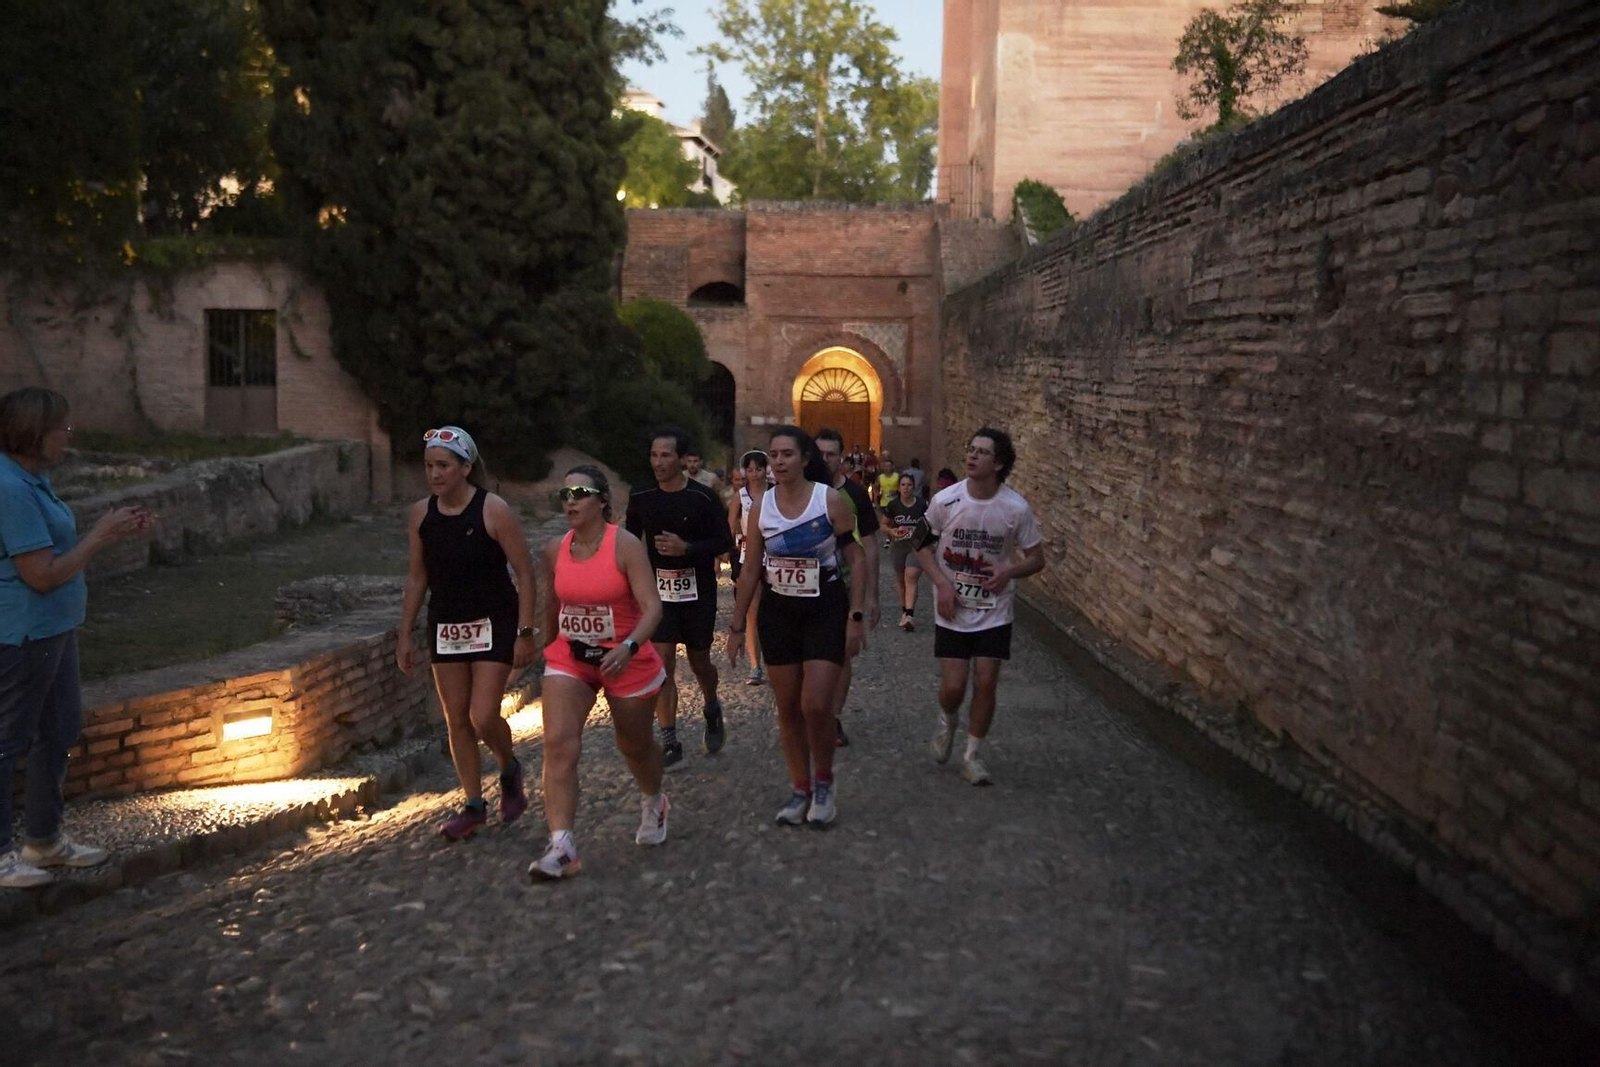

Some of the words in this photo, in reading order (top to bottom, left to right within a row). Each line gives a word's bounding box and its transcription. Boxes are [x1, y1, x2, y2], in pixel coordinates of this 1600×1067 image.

[953, 528, 964, 540] 40
[775, 569, 806, 584] 176
[659, 578, 690, 591] 2159
[561, 616, 604, 633] 4606
[440, 624, 482, 641] 4937
